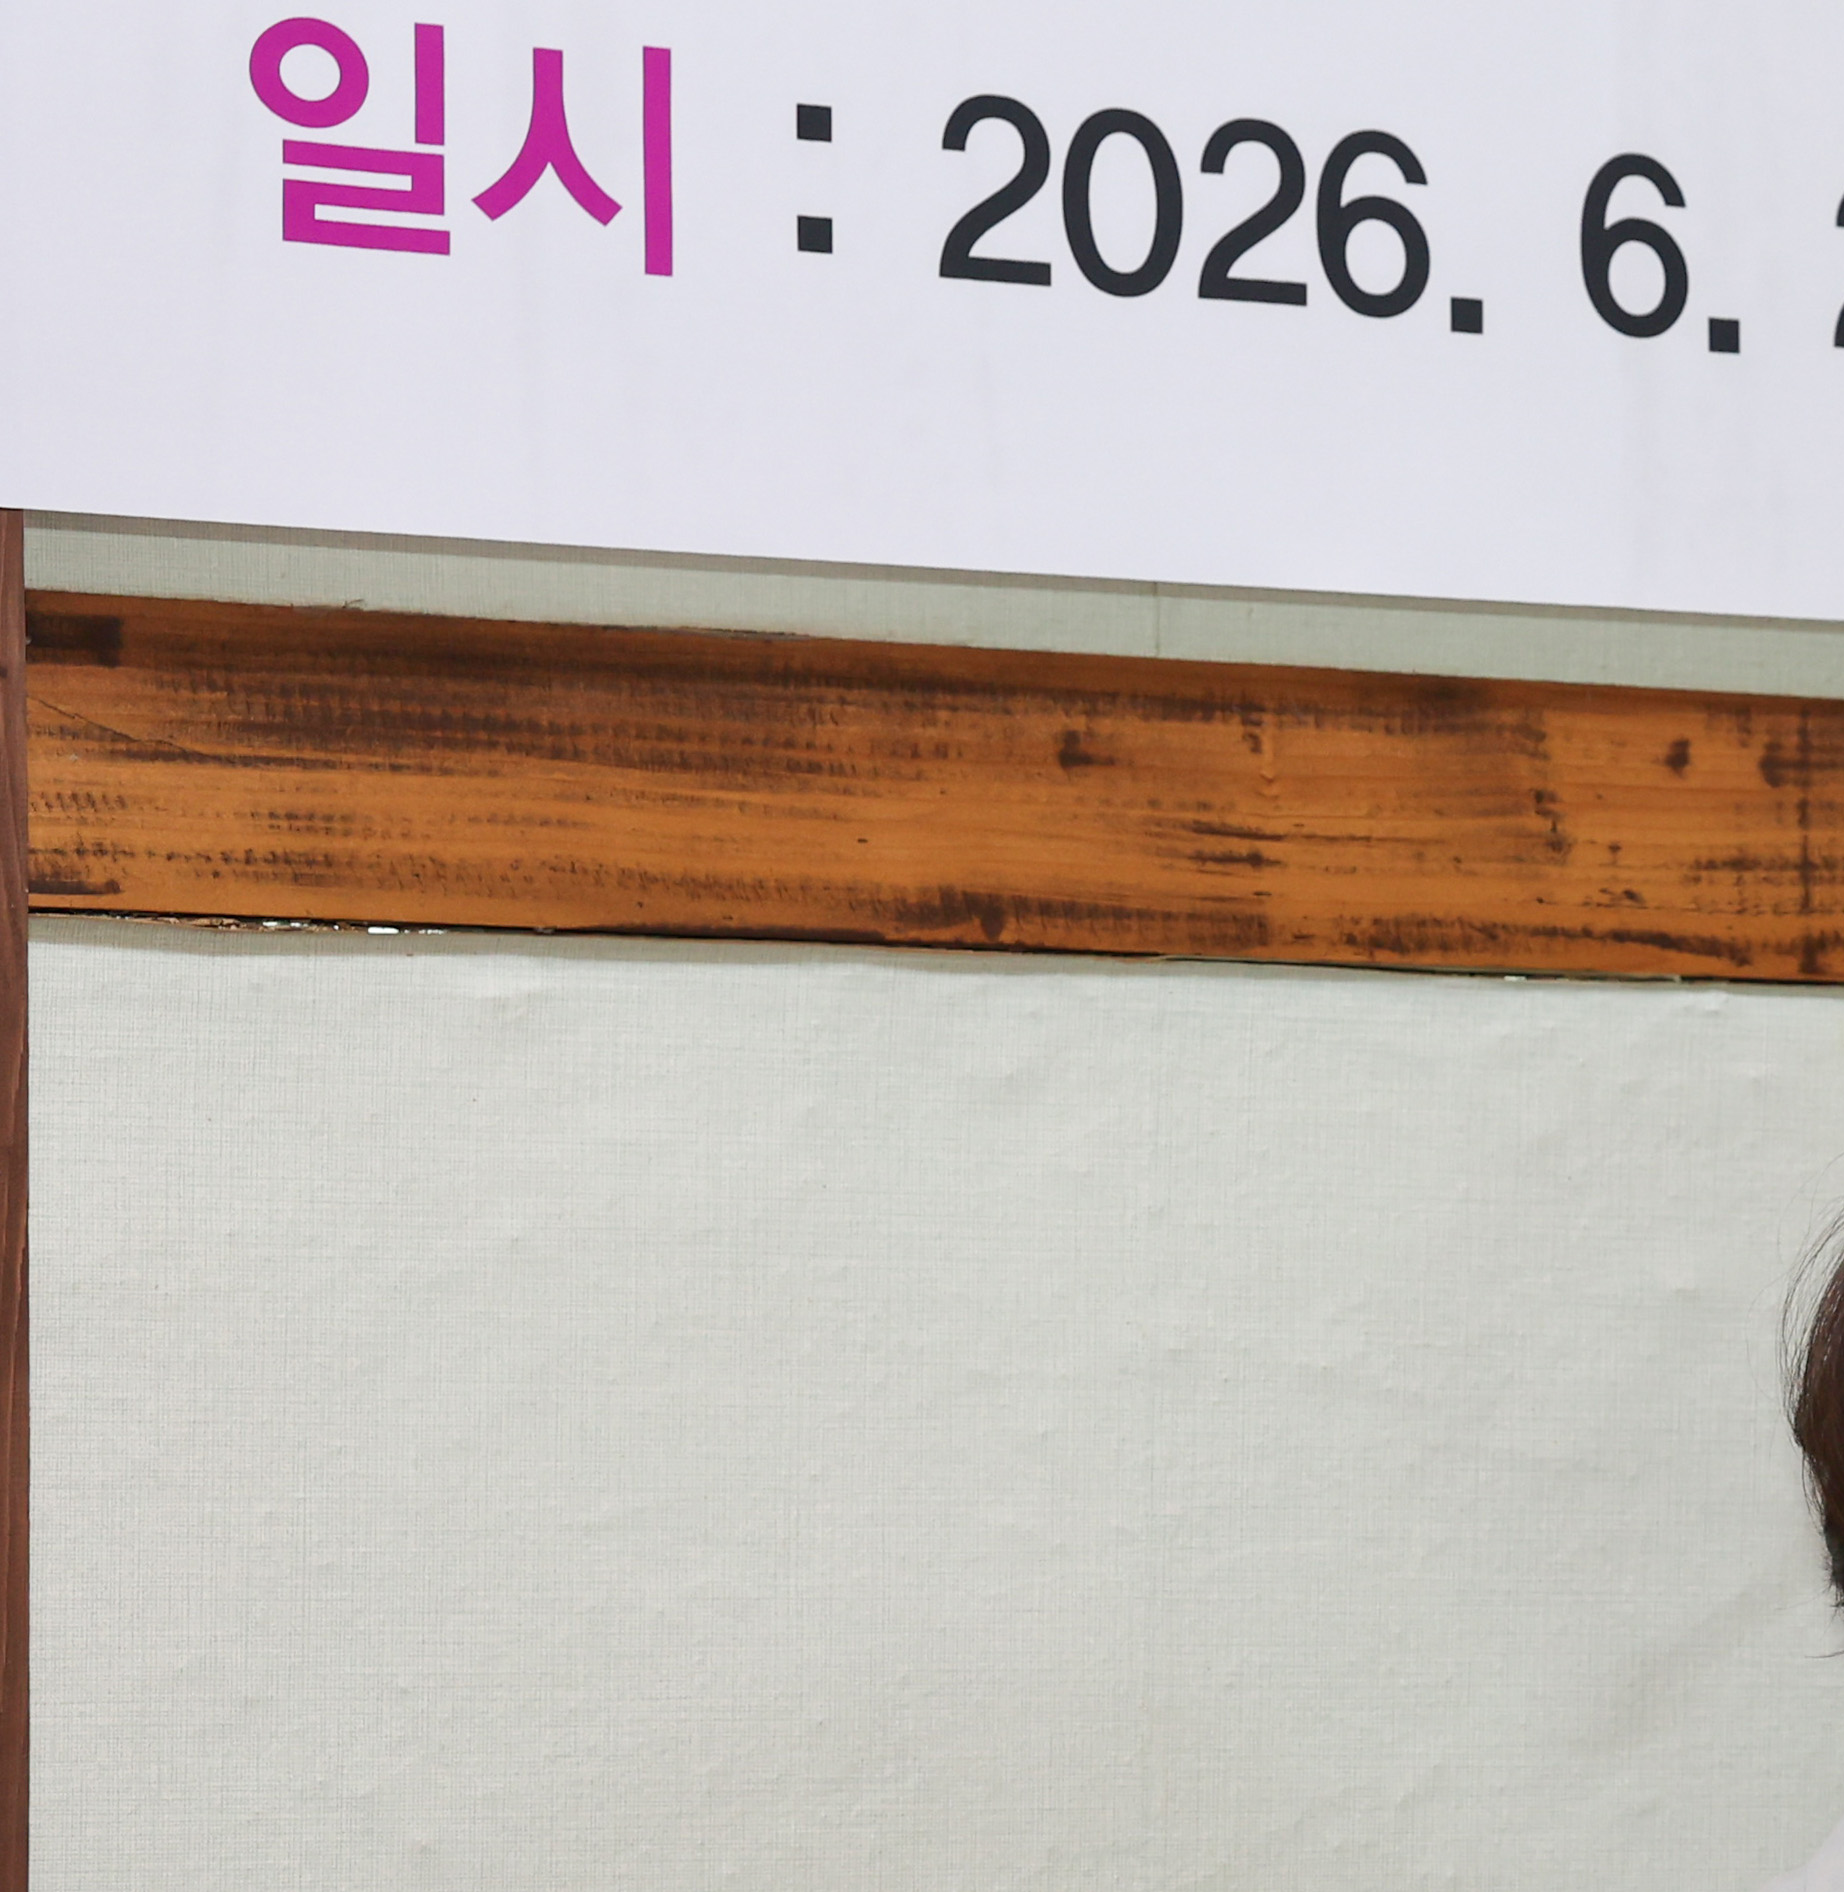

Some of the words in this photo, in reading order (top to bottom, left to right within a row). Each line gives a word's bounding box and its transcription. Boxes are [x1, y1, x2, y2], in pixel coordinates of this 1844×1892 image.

[249, 17, 673, 276] 일시
[939, 94, 1484, 334] 2026.
[1580, 154, 1740, 354] 6.
